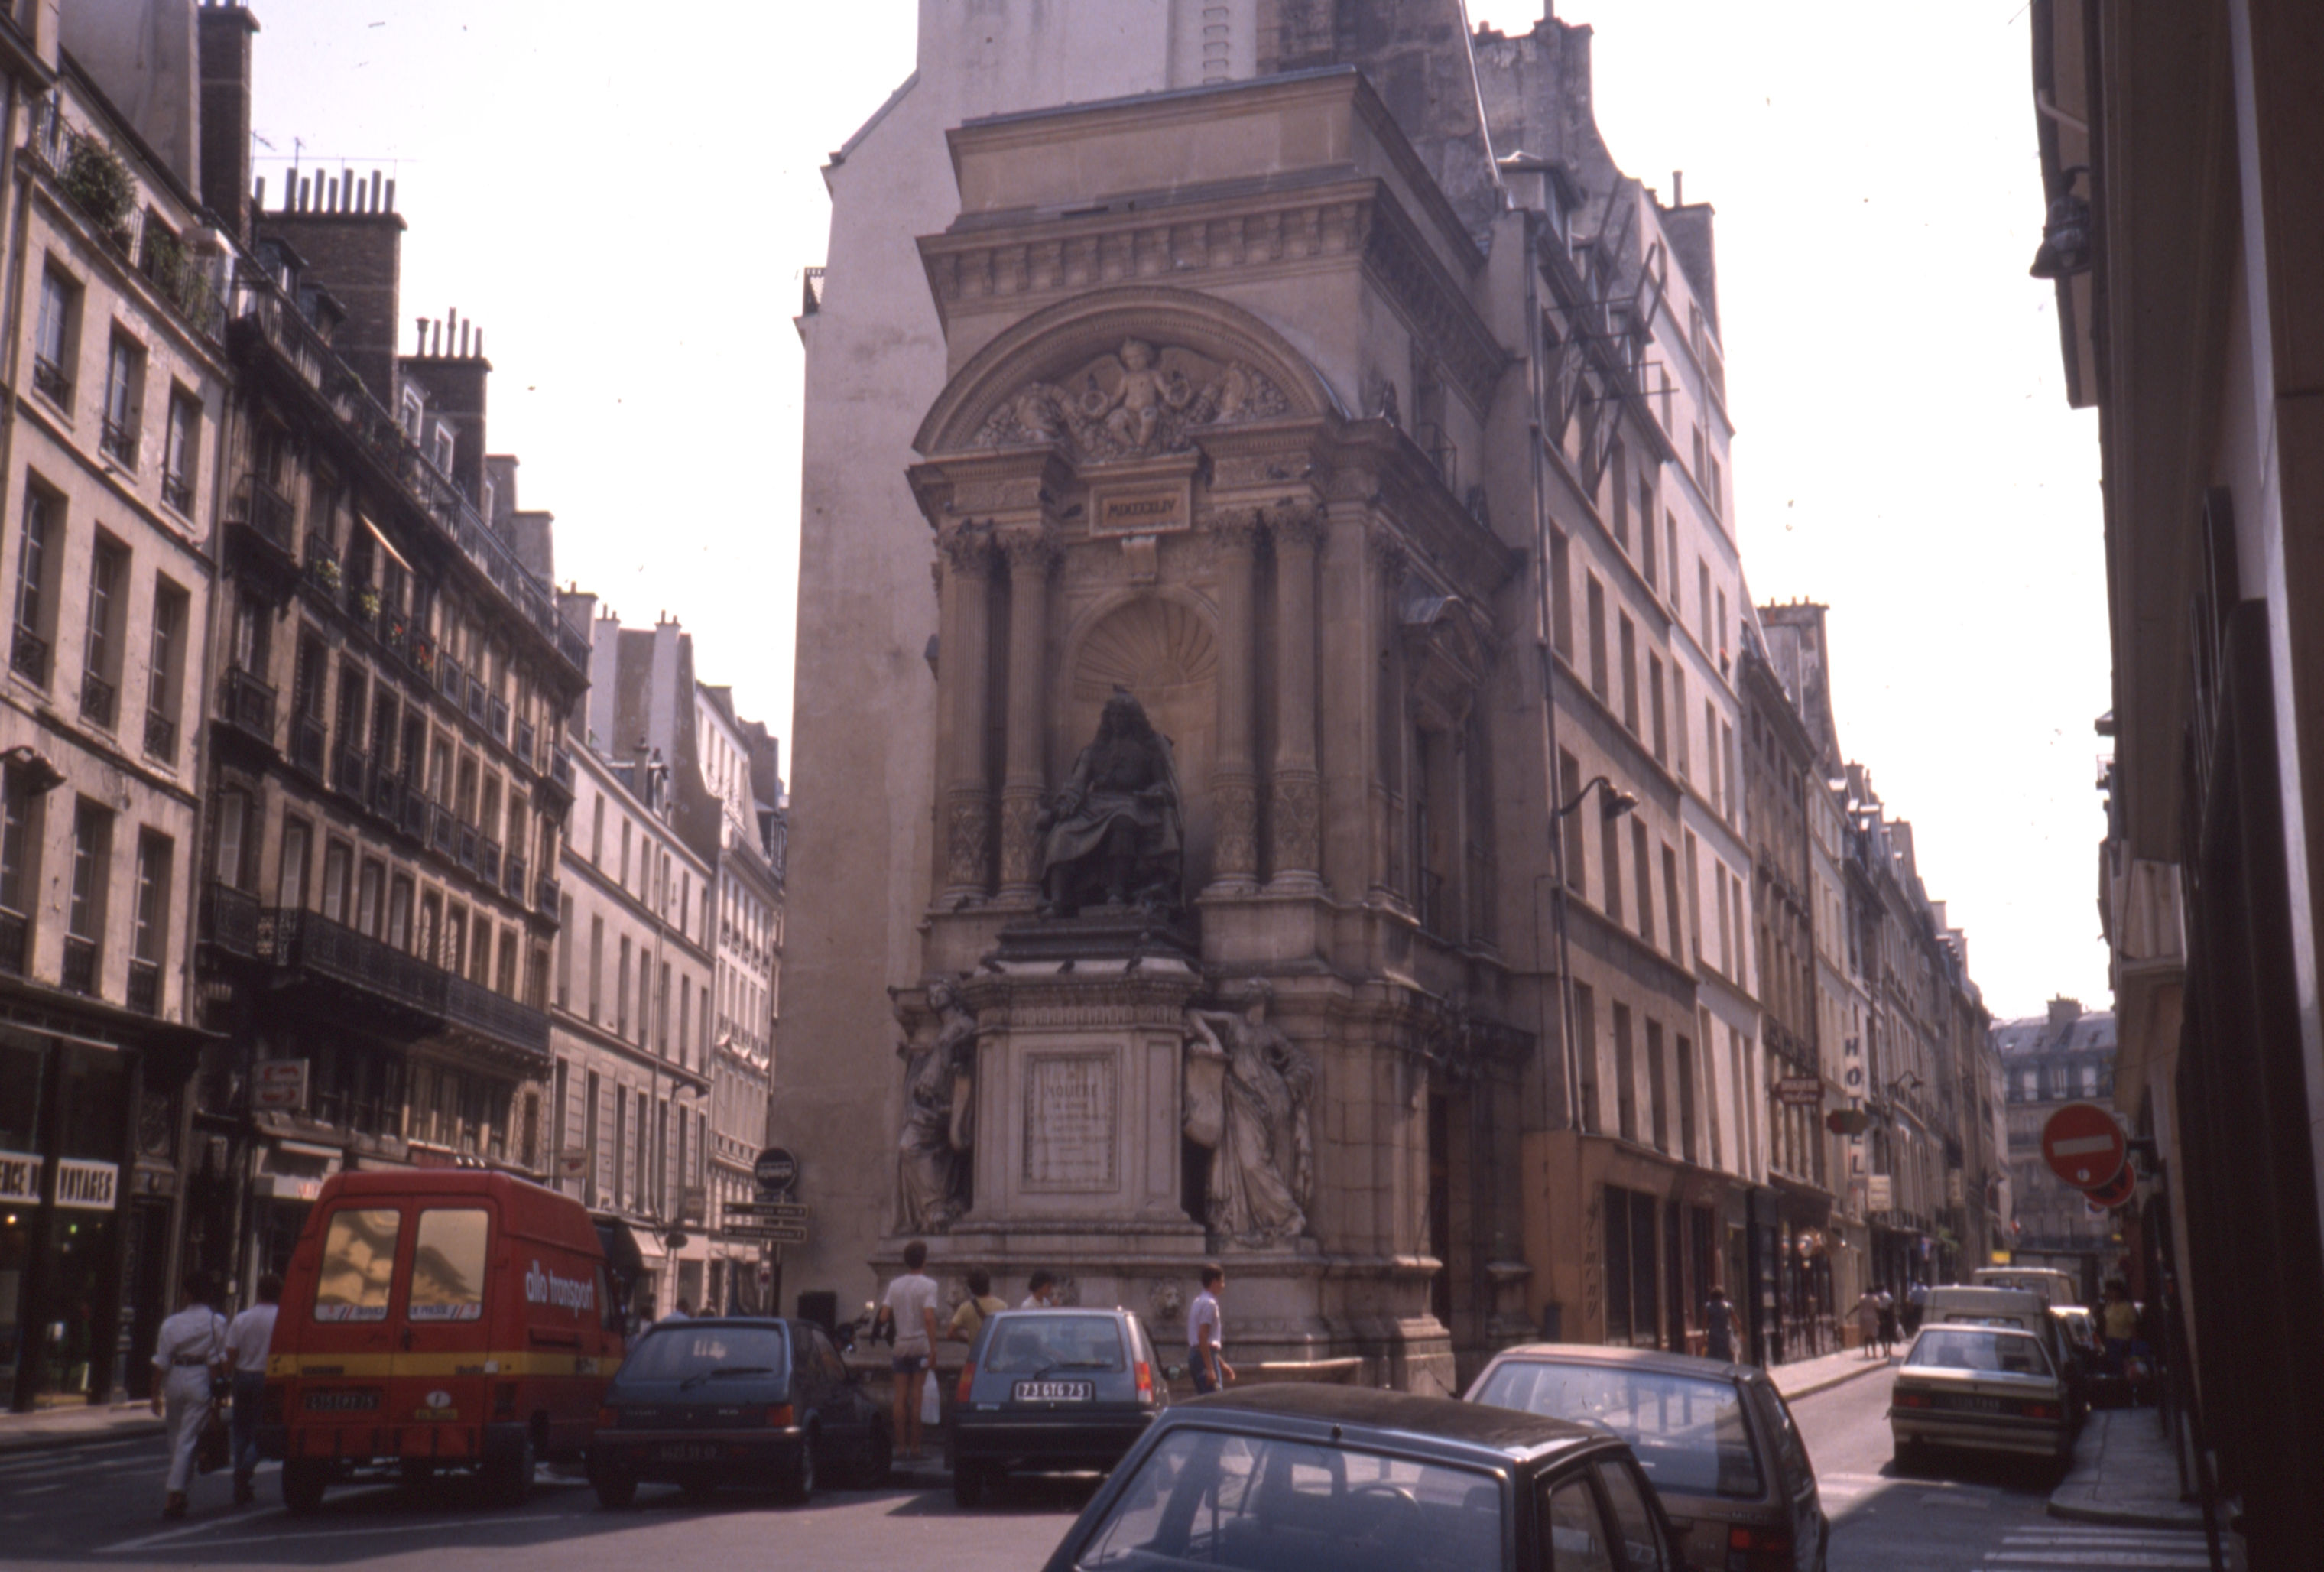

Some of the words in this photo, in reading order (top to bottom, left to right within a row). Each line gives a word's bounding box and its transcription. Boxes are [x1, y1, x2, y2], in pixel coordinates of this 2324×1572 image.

[59, 1166, 113, 1203] VOYAGES
[525, 1259, 547, 1304] allo
[549, 1268, 594, 1319] transport
[1023, 1383, 1038, 1397] 73
[1068, 1383, 1084, 1397] 75
